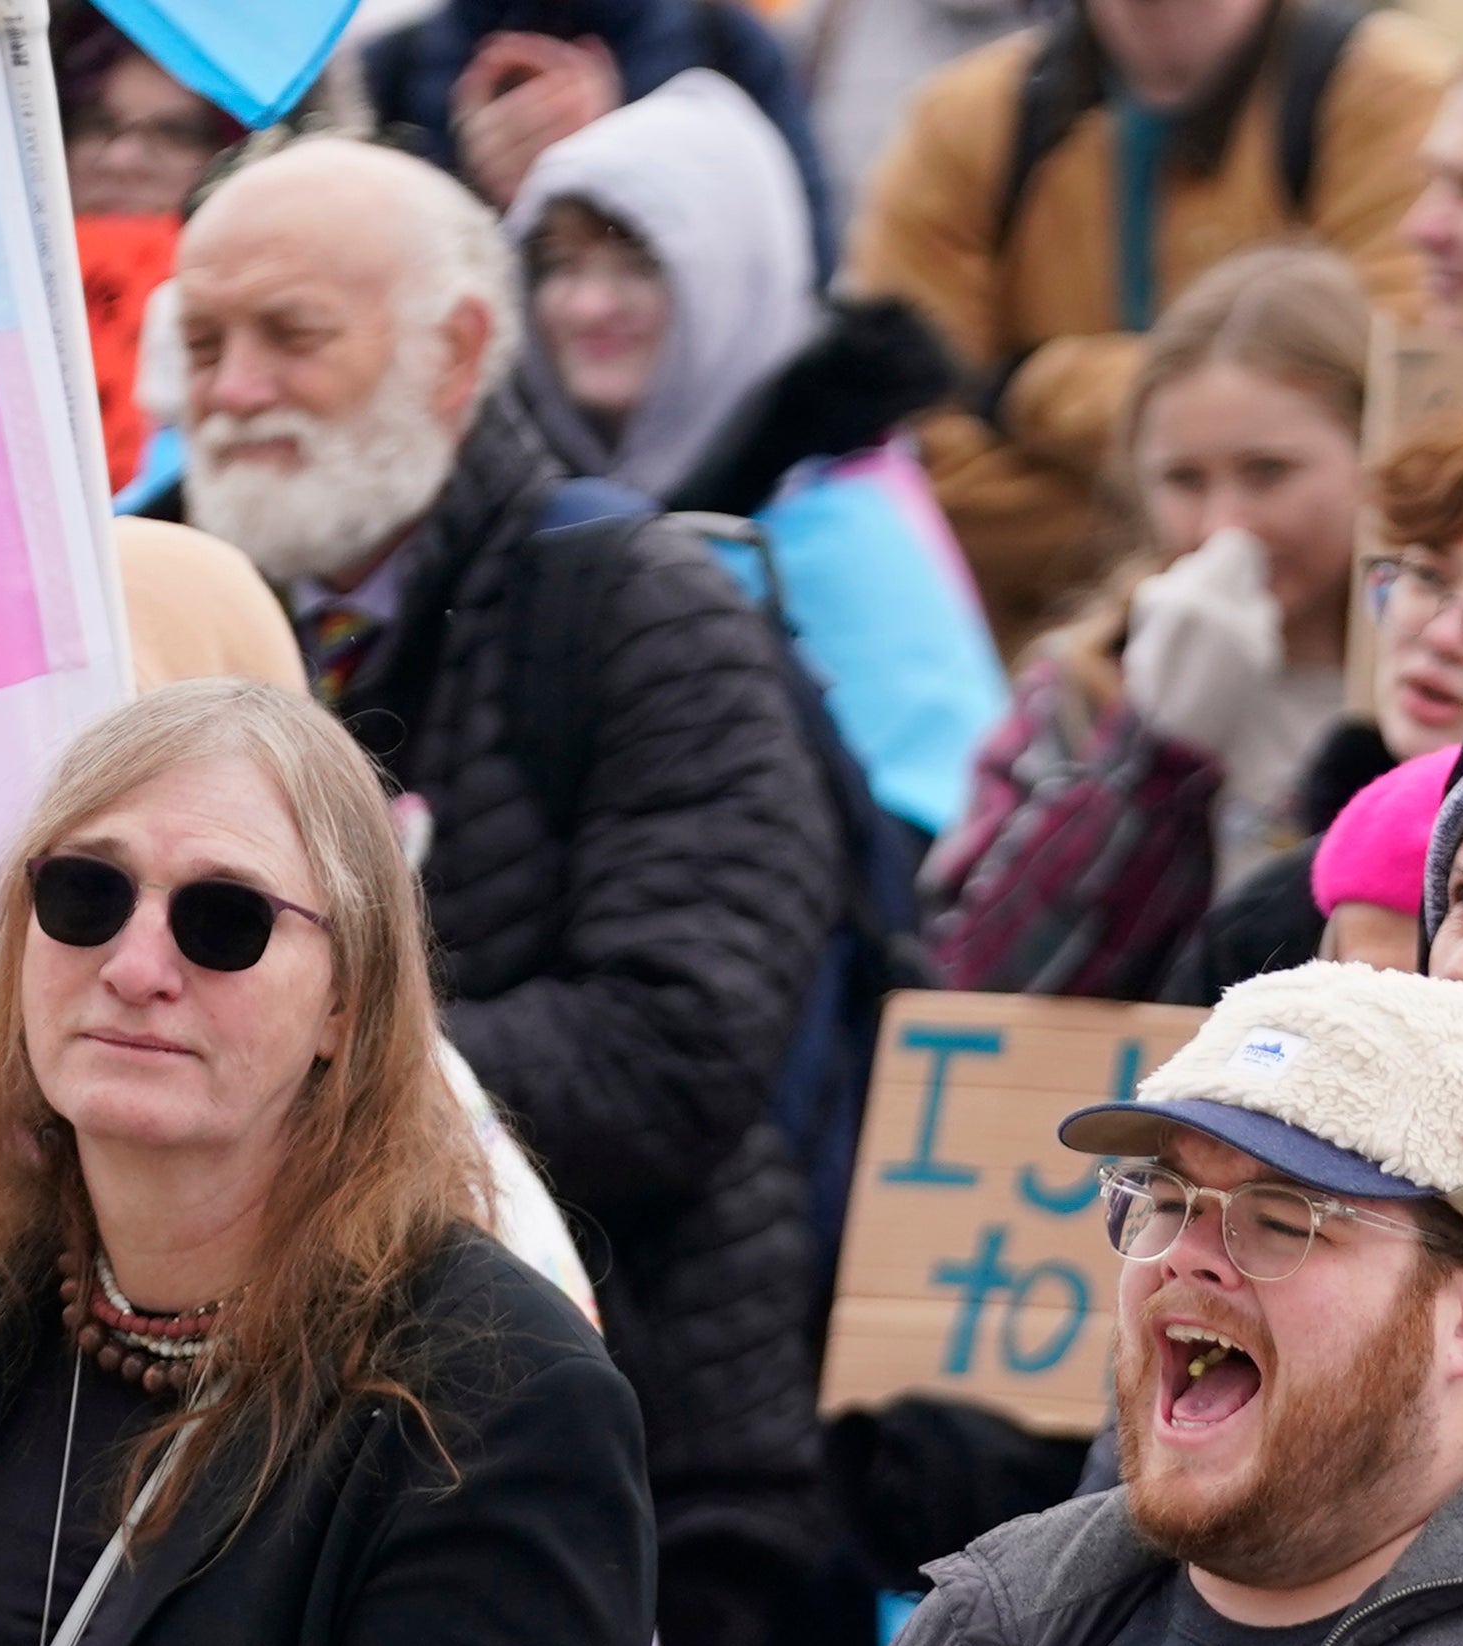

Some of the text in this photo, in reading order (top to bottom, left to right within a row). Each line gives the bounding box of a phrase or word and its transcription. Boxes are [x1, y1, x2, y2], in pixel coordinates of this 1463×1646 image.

[879, 1024, 1143, 1216] I J
[930, 1222, 1091, 1376] to
